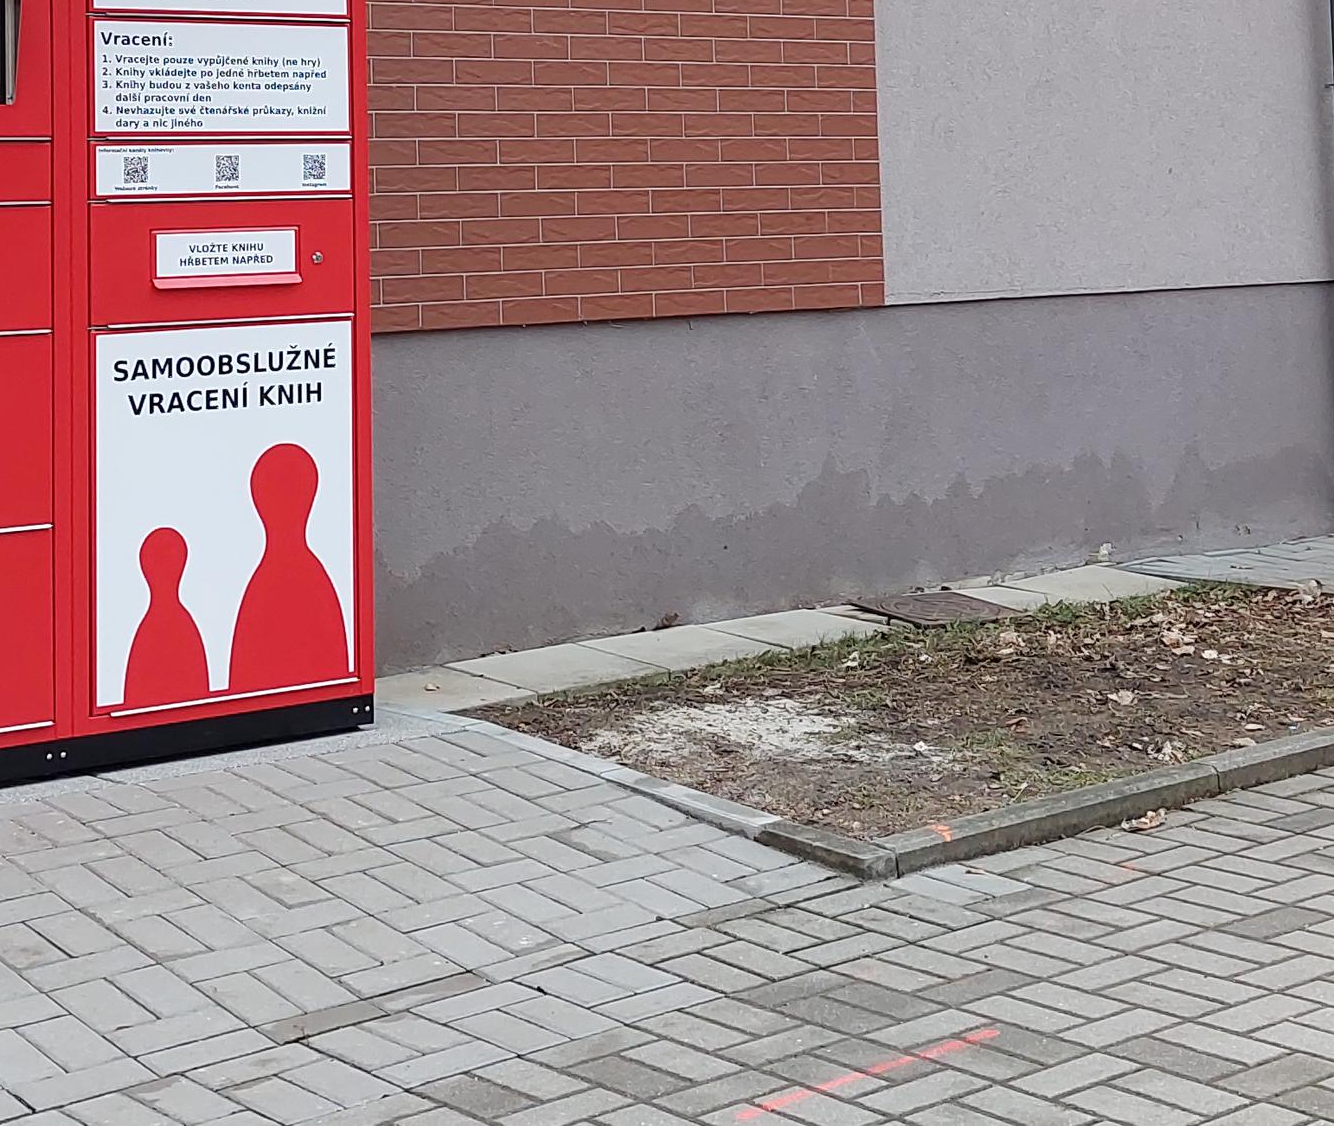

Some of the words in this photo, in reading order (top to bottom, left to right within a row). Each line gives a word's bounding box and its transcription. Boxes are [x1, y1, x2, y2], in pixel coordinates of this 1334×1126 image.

[100, 31, 173, 47] Vracení:
[102, 55, 112, 63] 1.
[115, 55, 160, 66] Vracejte
[163, 56, 194, 65] pouze
[197, 55, 249, 66] vypůjčené
[252, 57, 279, 67] knihy
[282, 57, 298, 68] (ne
[300, 58, 321, 68] hry)
[102, 67, 112, 76] 2.
[115, 67, 146, 78] Knihy
[149, 68, 197, 78] vkládejte
[216, 68, 244, 79] jedné
[247, 69, 289, 78] hřbetem
[292, 70, 327, 79] napřed
[102, 80, 112, 89] 3.
[115, 80, 146, 91] Knihy
[149, 81, 182, 89] budou
[193, 81, 230, 90] vašeho
[233, 81, 261, 90] konta
[264, 82, 312, 93] odepsány
[115, 93, 141, 102] další
[144, 93, 190, 103] pracovní
[192, 93, 212, 102] den
[102, 106, 113, 115] 4.
[116, 106, 176, 116] Nevhazujte
[178, 106, 196, 115] své
[199, 105, 249, 115] čtenářské
[252, 105, 294, 117] průkazy,
[297, 106, 327, 115] knižní
[115, 119, 140, 129] dary
[152, 119, 168, 128] nic
[170, 119, 203, 129] jiného
[188, 242, 229, 253] VLOŽTE
[231, 242, 264, 252] KNIHU
[179, 255, 229, 267] HŘBETEM
[232, 254, 273, 265] NAPŘED
[113, 343, 337, 382] SAMOOBSLUŽNÉ
[128, 382, 249, 416] VRACENÍ
[259, 382, 323, 407] KNIH
